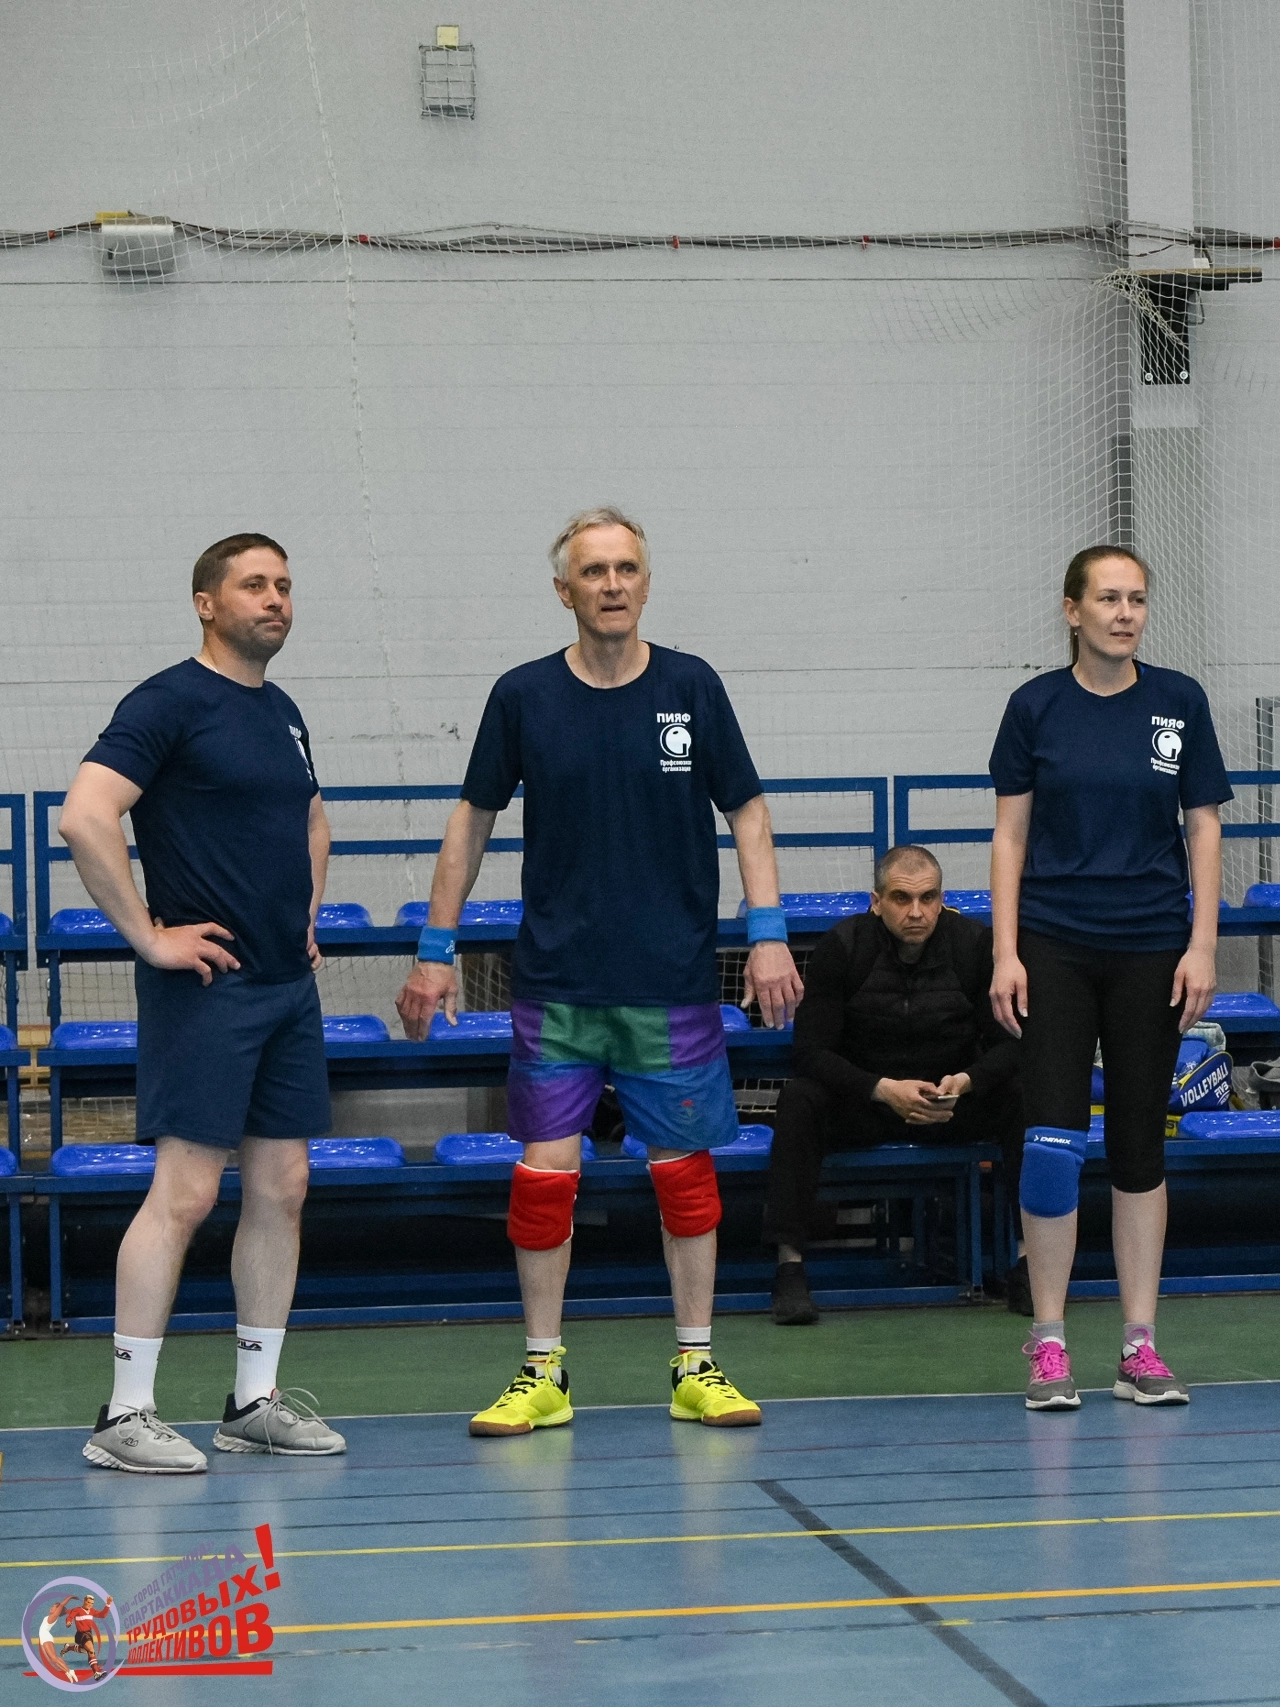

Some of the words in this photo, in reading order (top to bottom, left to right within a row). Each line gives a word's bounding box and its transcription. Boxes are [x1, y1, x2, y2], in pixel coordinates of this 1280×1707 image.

[656, 712, 691, 723] ПИЯФ
[1151, 716, 1185, 729] ПИЯФ
[1180, 1062, 1229, 1107] VOLLEYBALL
[1040, 1136, 1072, 1145] DEMIX
